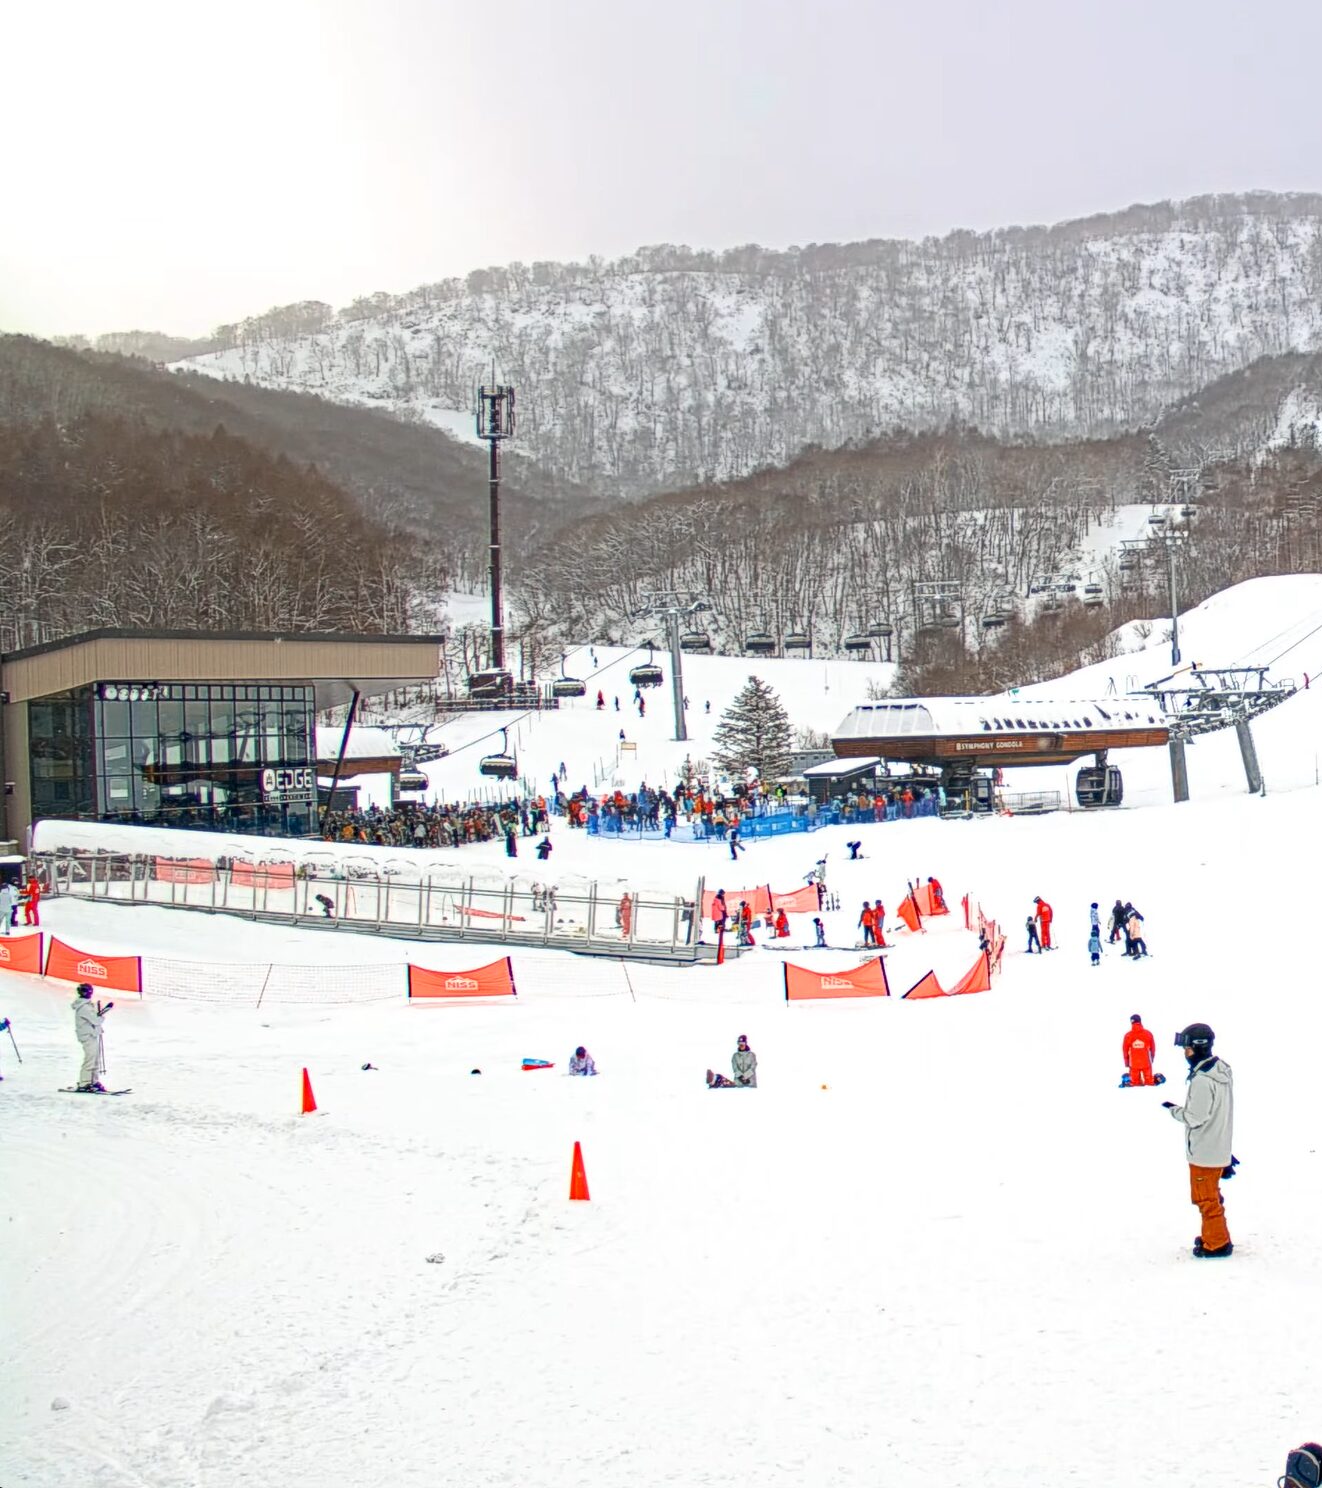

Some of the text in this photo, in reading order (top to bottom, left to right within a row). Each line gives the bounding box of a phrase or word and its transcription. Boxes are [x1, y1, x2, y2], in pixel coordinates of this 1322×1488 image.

[961, 741, 1023, 750] SYMPHONY GONDOLA
[276, 768, 313, 789] EDGE
[79, 963, 106, 976] NISS
[446, 981, 476, 989] NISS
